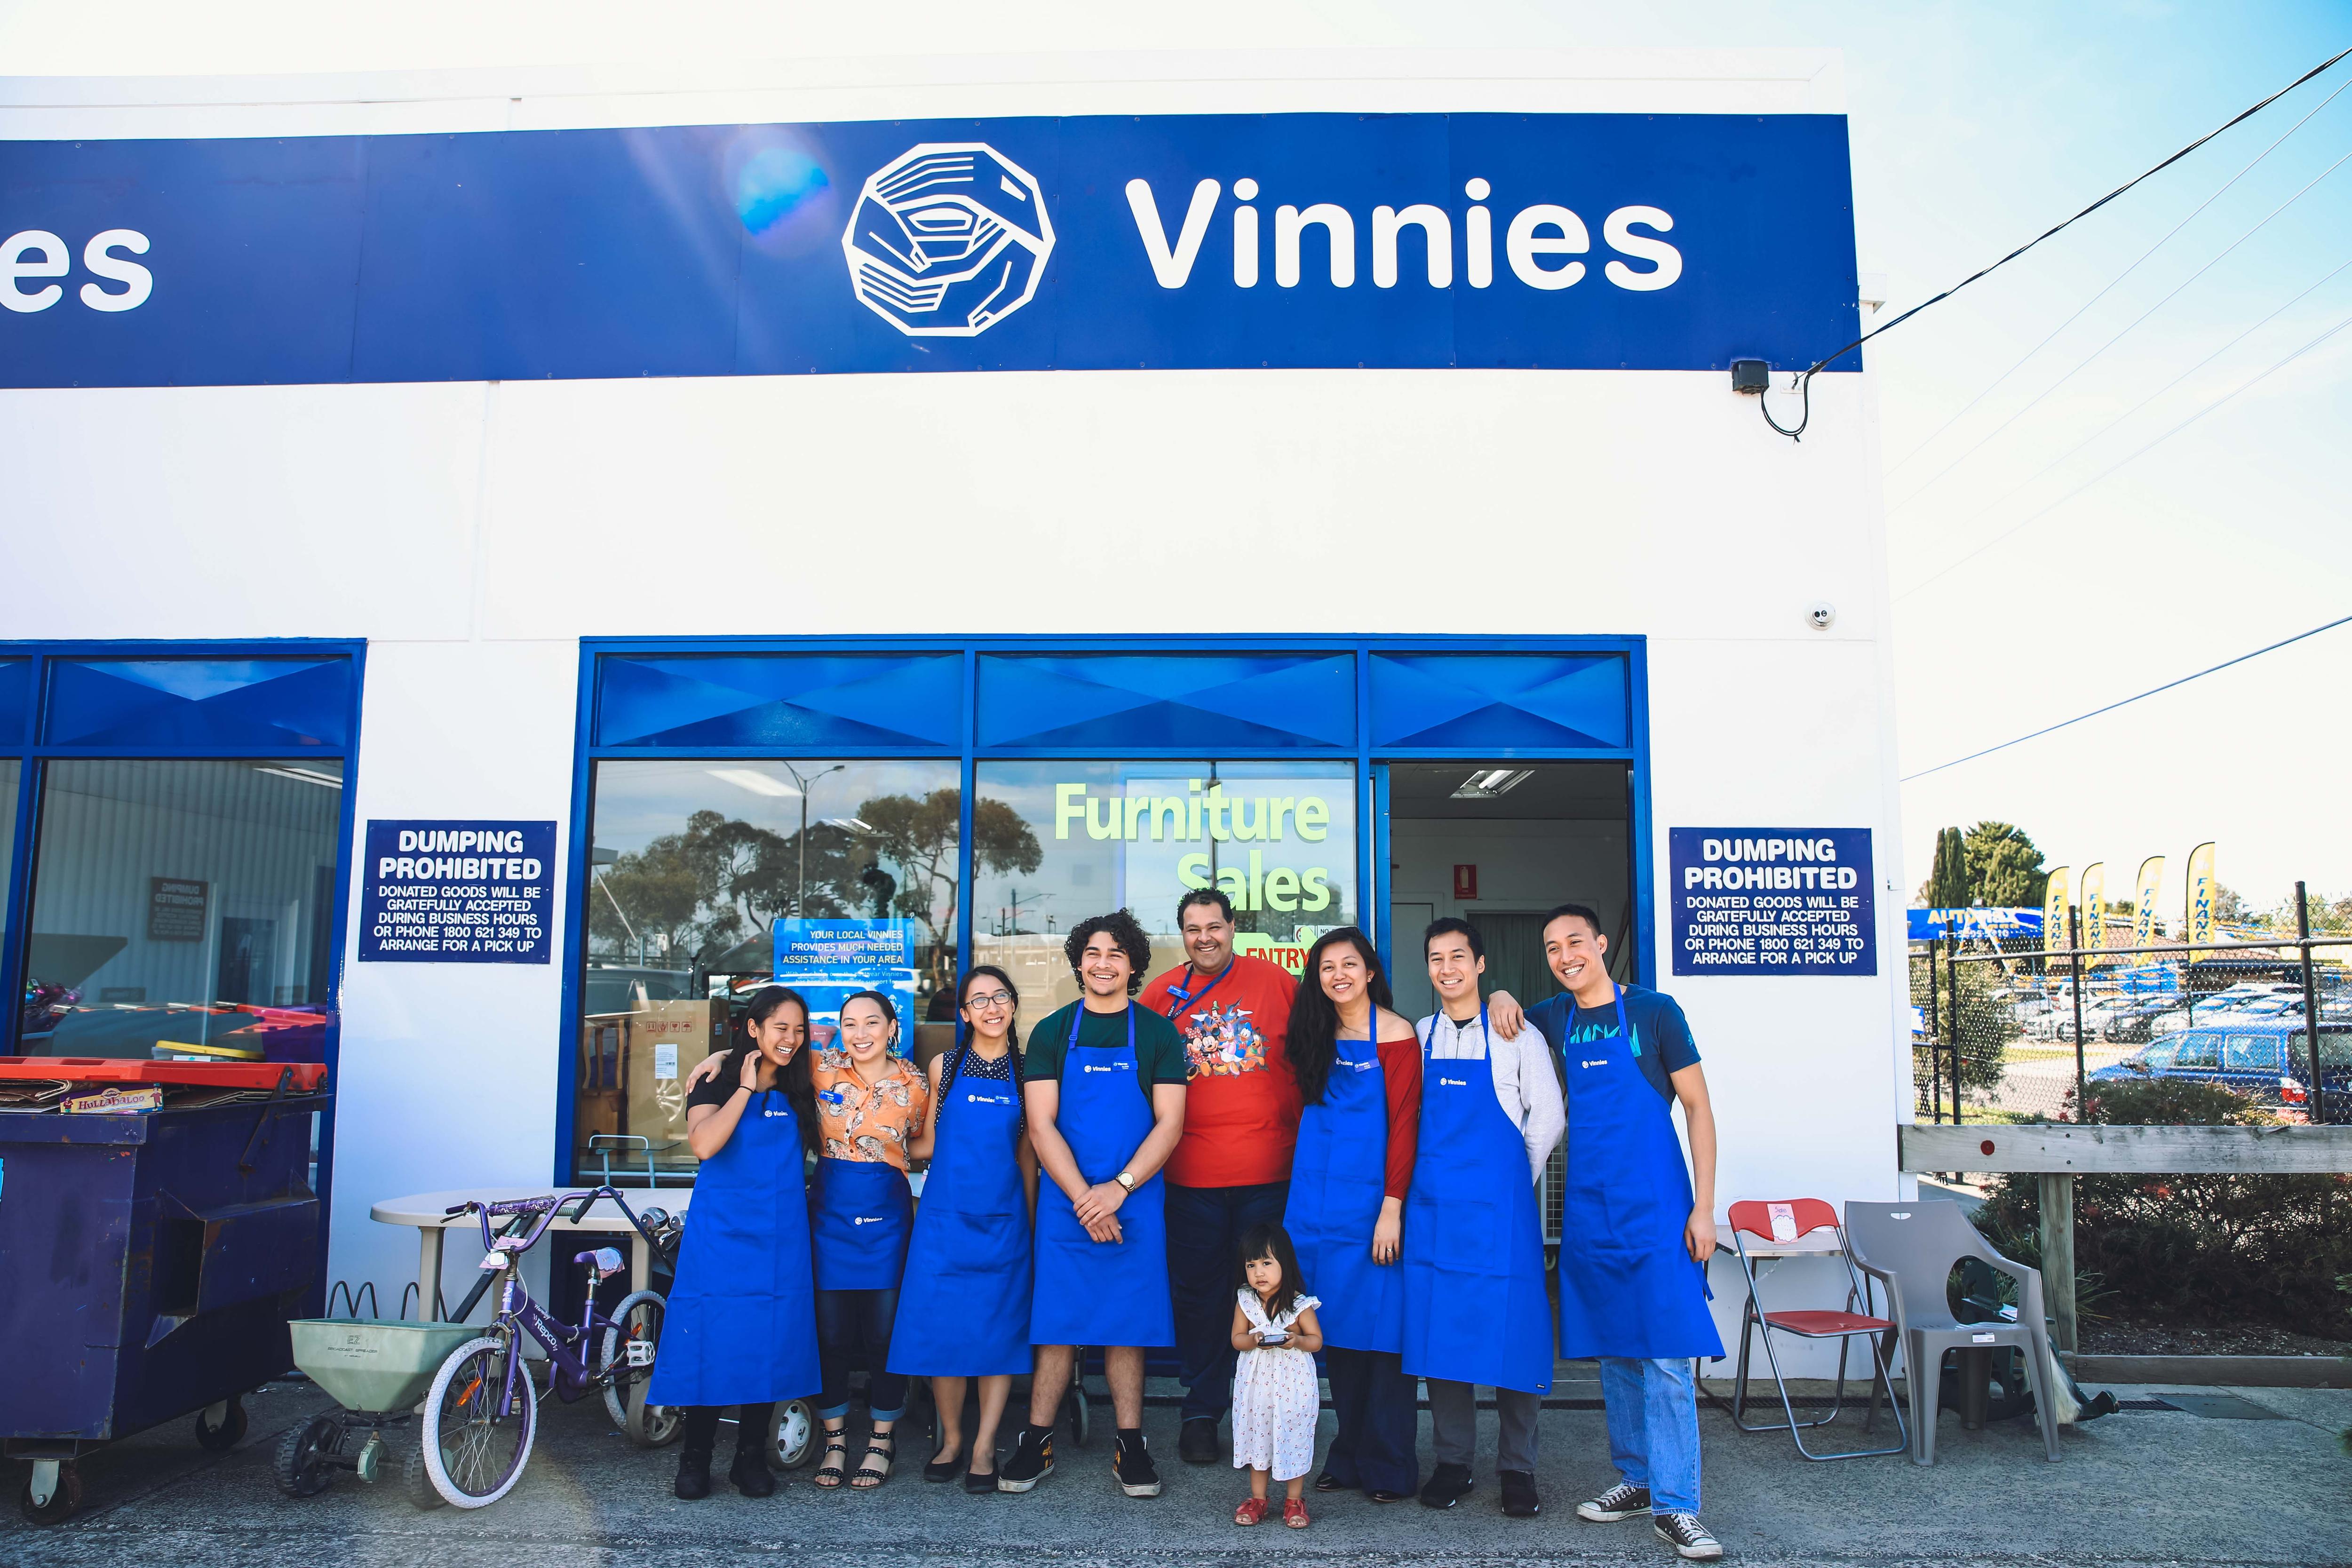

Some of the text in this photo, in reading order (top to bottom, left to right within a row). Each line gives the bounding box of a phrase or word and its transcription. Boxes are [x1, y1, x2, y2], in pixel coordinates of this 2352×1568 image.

[1125, 178, 1683, 291] Vinnies
[0, 229, 153, 313] es
[1055, 779, 1330, 841] Furniture
[399, 830, 523, 853] DUMPING
[1703, 838, 1836, 861] DUMPING
[379, 857, 541, 880] PROHIBITED
[1685, 867, 1857, 890] PROHIBITED
[379, 885, 541, 898] DONATED GOODS WILL BE
[1177, 850, 1330, 912] Sales
[387, 899, 531, 912] GRATEFULLY ACCEPTED
[1686, 896, 1859, 908] DONATED GOODS WILL BE
[2195, 877, 2209, 945] FINANC
[379, 912, 537, 925] DURING BUSINESS HOURS
[1697, 910, 1850, 922] GRATEFULLY ACCEPTED
[2051, 895, 2062, 949] FINANC
[2090, 893, 2101, 957] FINANC
[2137, 889, 2154, 956] FINANC
[373, 925, 542, 939] OR PHONE 1800 621 349 TO
[810, 931, 834, 939] YOUR
[837, 931, 865, 939] LOCAL
[1689, 924, 1858, 936] DURING BUSINESS HOURS
[379, 939, 534, 952] ARRANGE FOR A PICK UP
[1685, 938, 1864, 950] OR PHONE 1800 621 349 TO
[1692, 952, 1857, 964] ARRANGE FOR A PICK UP
[347, 1335, 361, 1345] EZ
[534, 1318, 556, 1346] Repco
